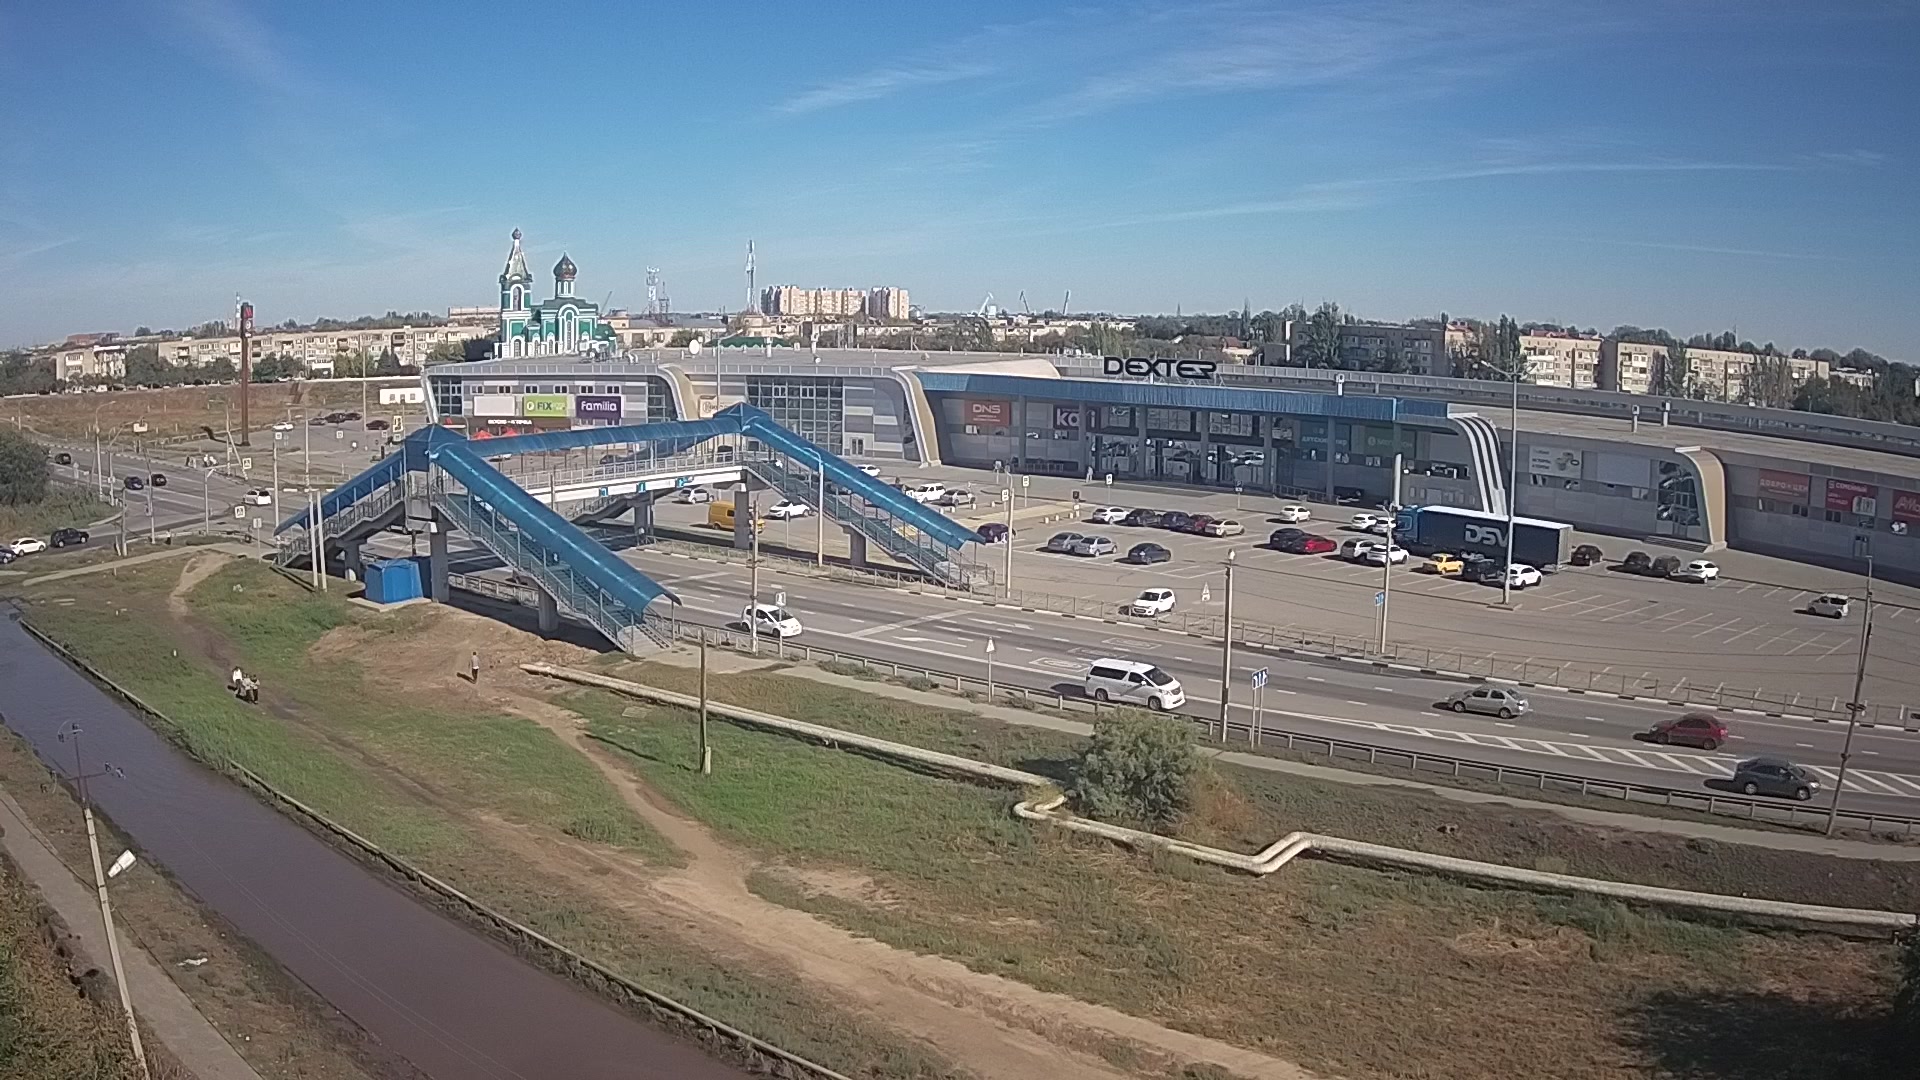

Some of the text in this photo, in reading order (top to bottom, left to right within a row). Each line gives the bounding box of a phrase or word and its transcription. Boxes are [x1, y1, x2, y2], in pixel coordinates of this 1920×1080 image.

[1103, 356, 1217, 380] DEXTER
[537, 402, 552, 411] FIX
[581, 401, 617, 411] Familia
[972, 404, 1001, 414] DNS
[1464, 524, 1509, 547] DSV
